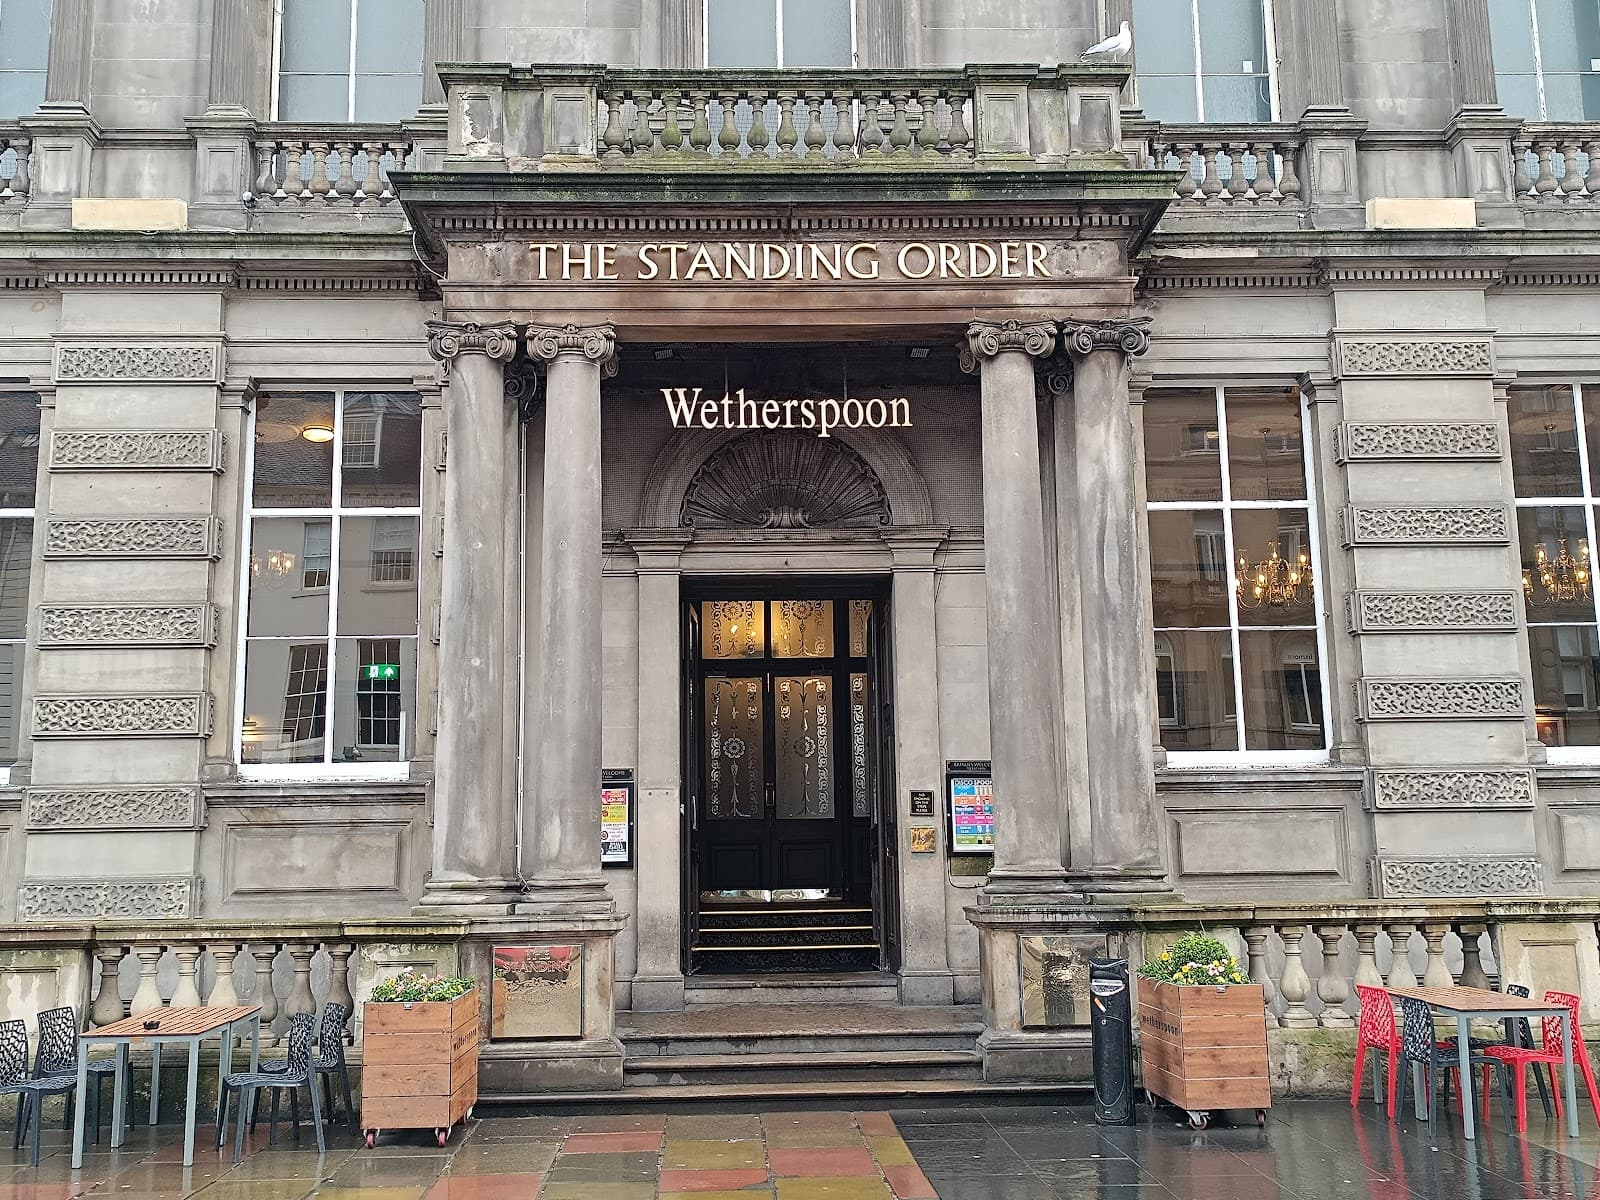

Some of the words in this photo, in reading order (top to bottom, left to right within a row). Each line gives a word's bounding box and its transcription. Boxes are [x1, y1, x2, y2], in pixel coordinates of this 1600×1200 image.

[528, 242, 619, 281] THE
[637, 242, 878, 281] STANDING
[897, 240, 1053, 280] ORDER
[660, 387, 914, 438] Wetherspoon
[502, 960, 572, 973] STANDING
